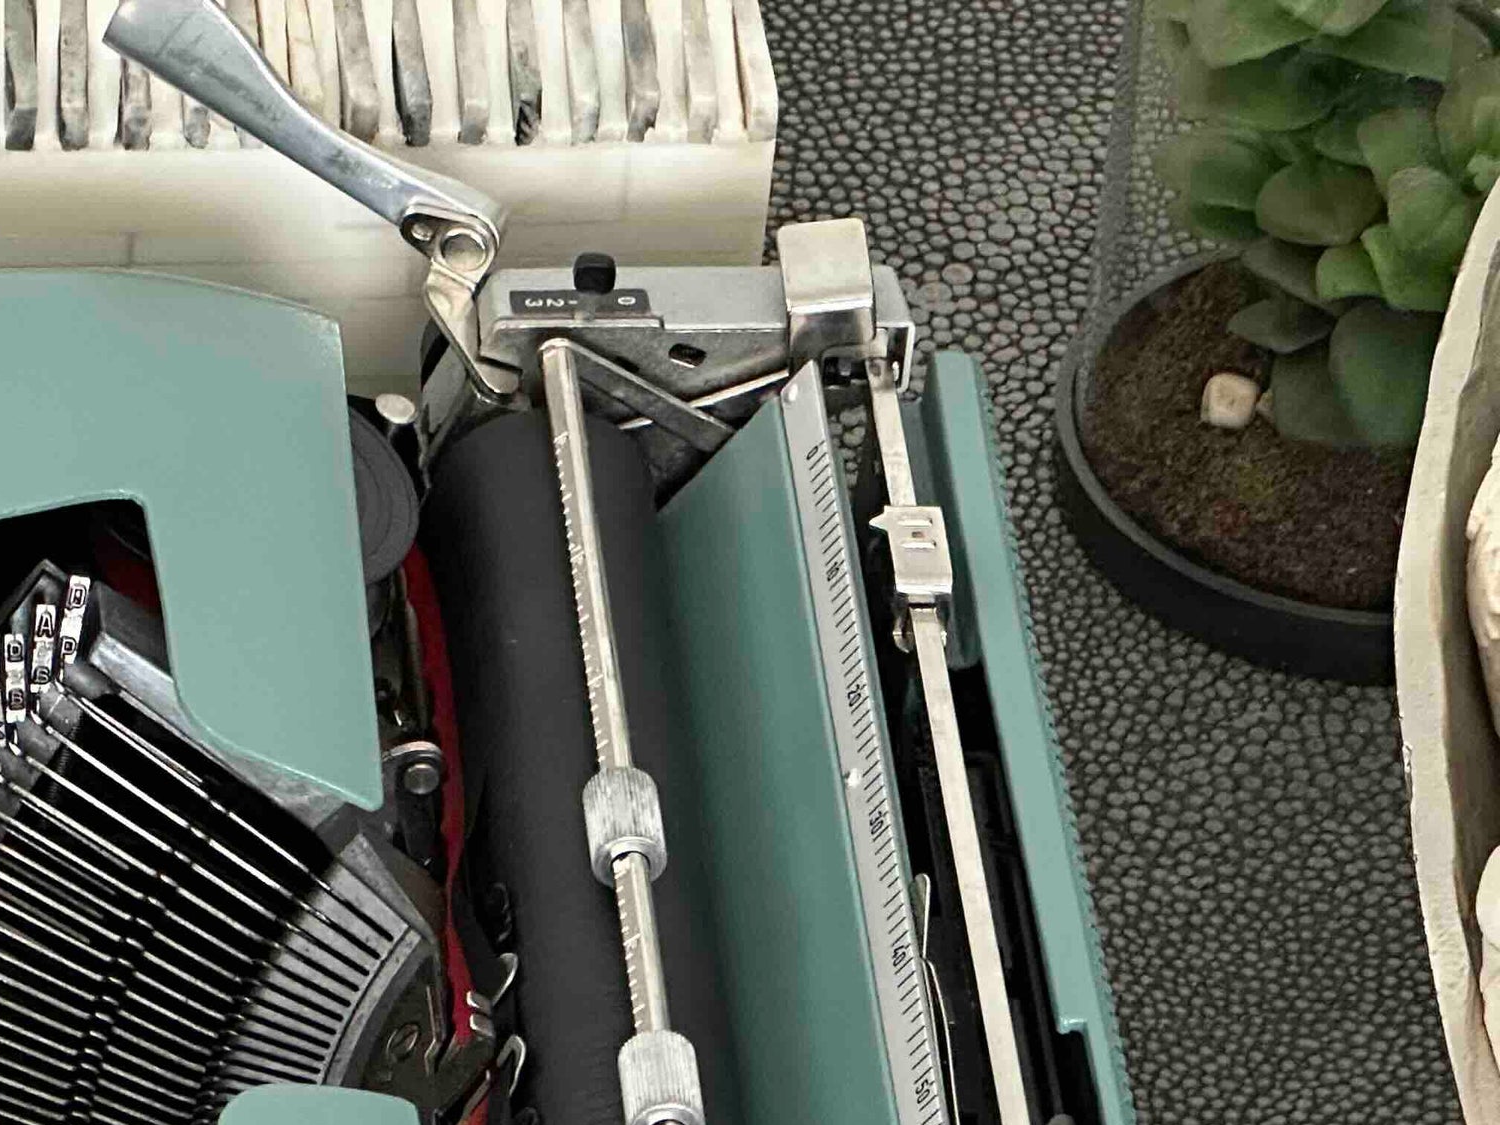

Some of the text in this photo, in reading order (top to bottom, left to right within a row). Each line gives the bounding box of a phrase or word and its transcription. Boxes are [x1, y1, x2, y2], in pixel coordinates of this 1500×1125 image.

[524, 298, 544, 307] 3
[546, 298, 565, 307] 2
[806, 445, 819, 460] 0
[847, 684, 861, 707] 20
[869, 811, 884, 834] 30
[892, 946, 907, 966] 40
[914, 1079, 930, 1104] 50
